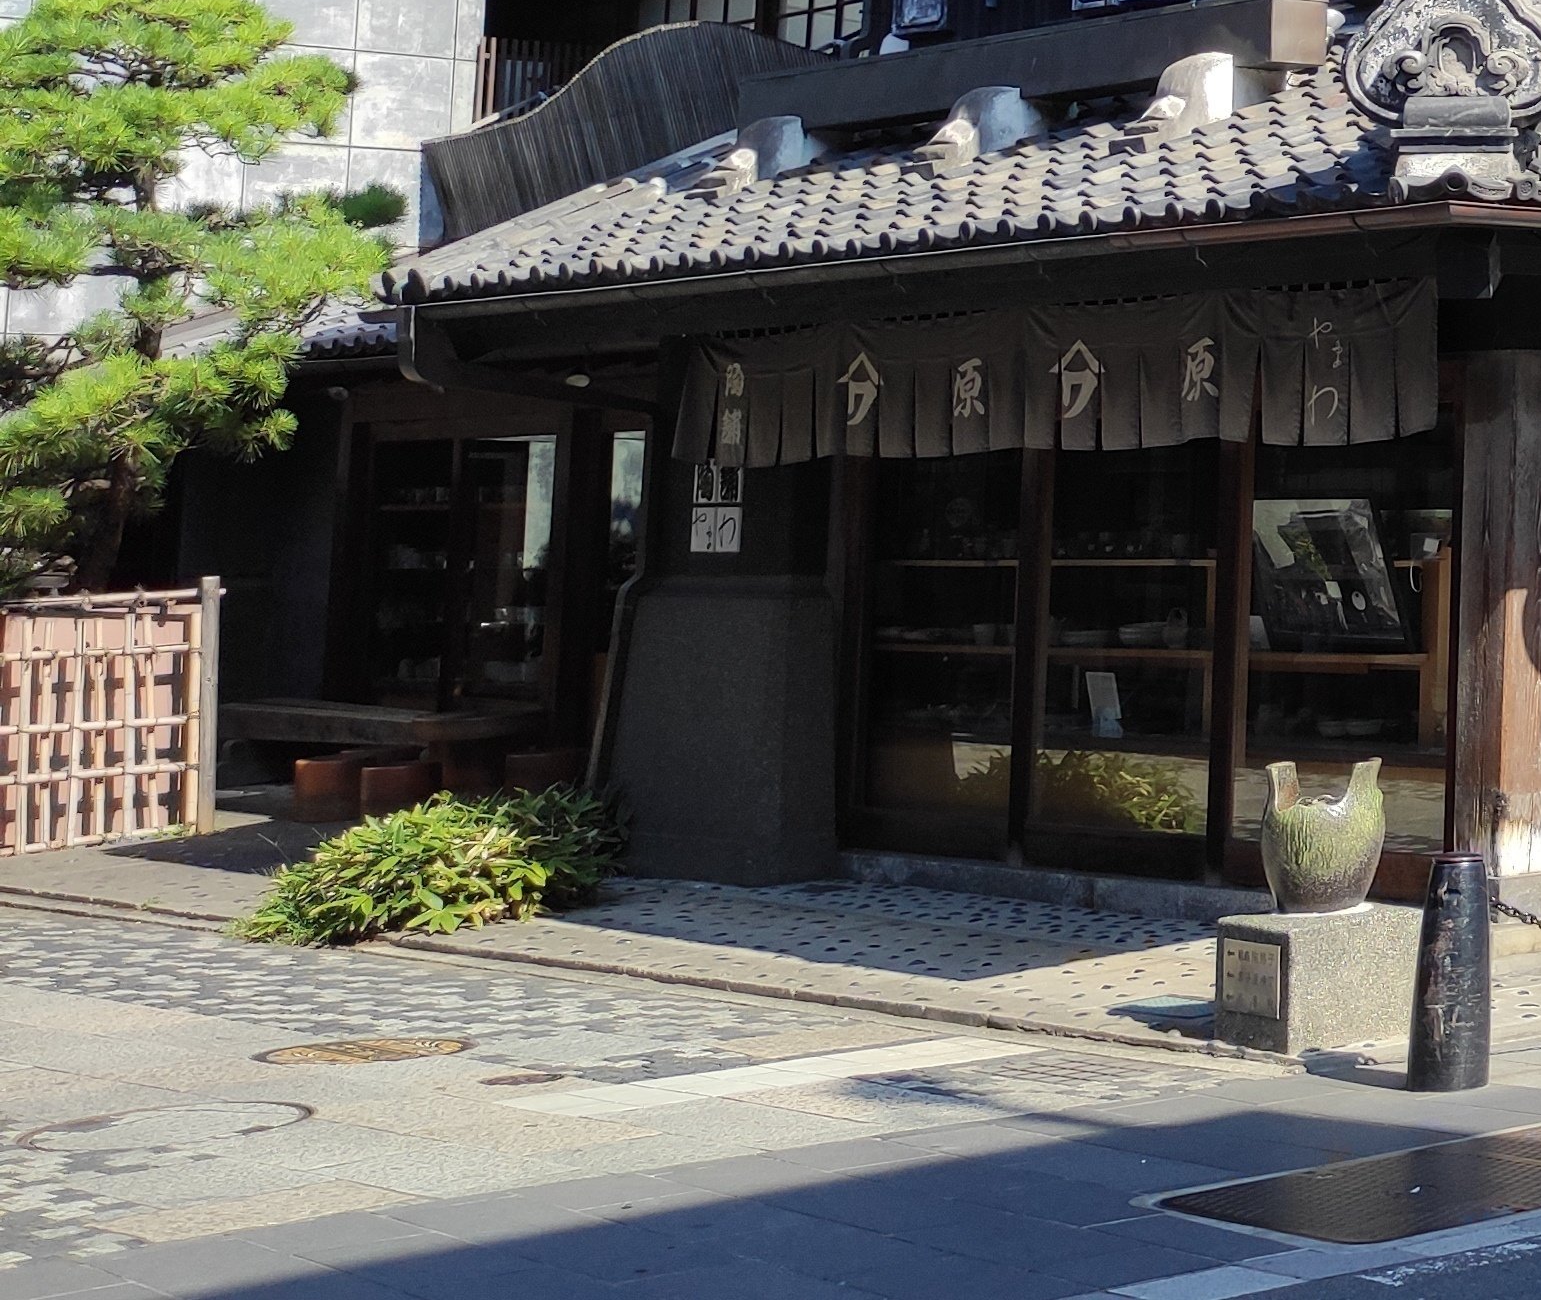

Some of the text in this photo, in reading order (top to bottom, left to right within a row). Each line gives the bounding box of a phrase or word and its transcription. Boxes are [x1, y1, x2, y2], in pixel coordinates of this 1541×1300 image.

[721, 361, 745, 445] 陶舗
[953, 357, 990, 418] 原
[1181, 336, 1219, 401] 原
[1306, 317, 1346, 426] やまわ
